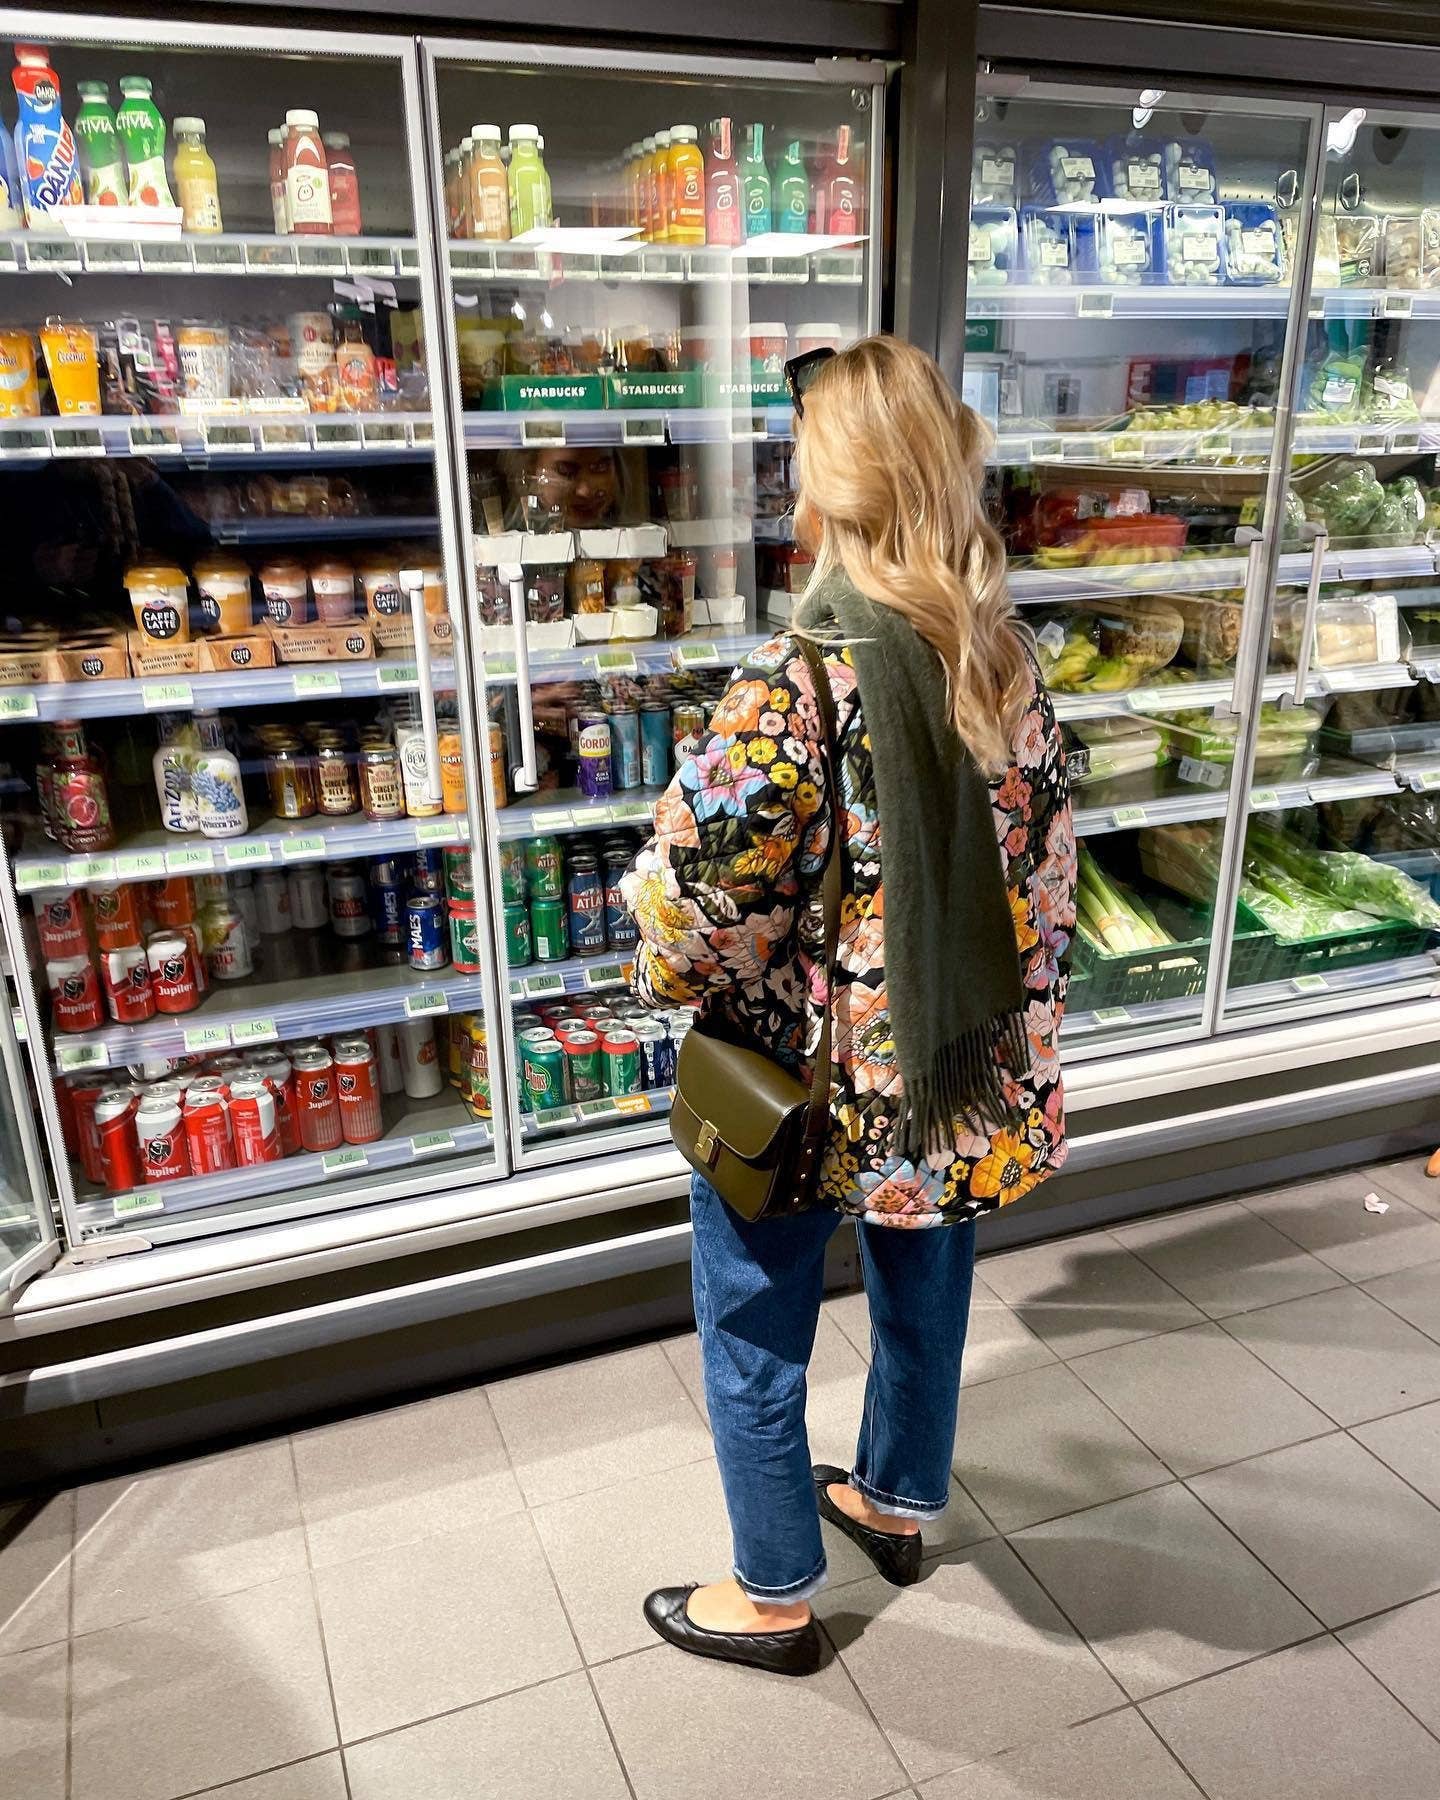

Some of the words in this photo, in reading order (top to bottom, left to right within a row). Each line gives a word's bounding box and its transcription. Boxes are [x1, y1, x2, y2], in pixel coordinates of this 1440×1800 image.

[114, 111, 154, 131] CTIVIA
[40, 121, 75, 206] DANUP
[520, 386, 586, 399] STARBUCKS
[622, 384, 684, 396] STARBUCKS
[719, 383, 780, 394] STARBUCKS
[146, 620, 177, 630] LATTE
[580, 735, 610, 750] GORDO
[576, 896, 604, 910] ATLAS
[43, 929, 82, 943] Jupiler
[408, 914, 424, 950] MAES
[615, 929, 636, 940] BEER
[584, 934, 604, 946] BEER
[158, 981, 194, 998] Jupiler
[58, 1001, 96, 1016] Jupiler
[308, 1098, 334, 1111] Jupiler
[146, 1164, 182, 1178] Jupiler
